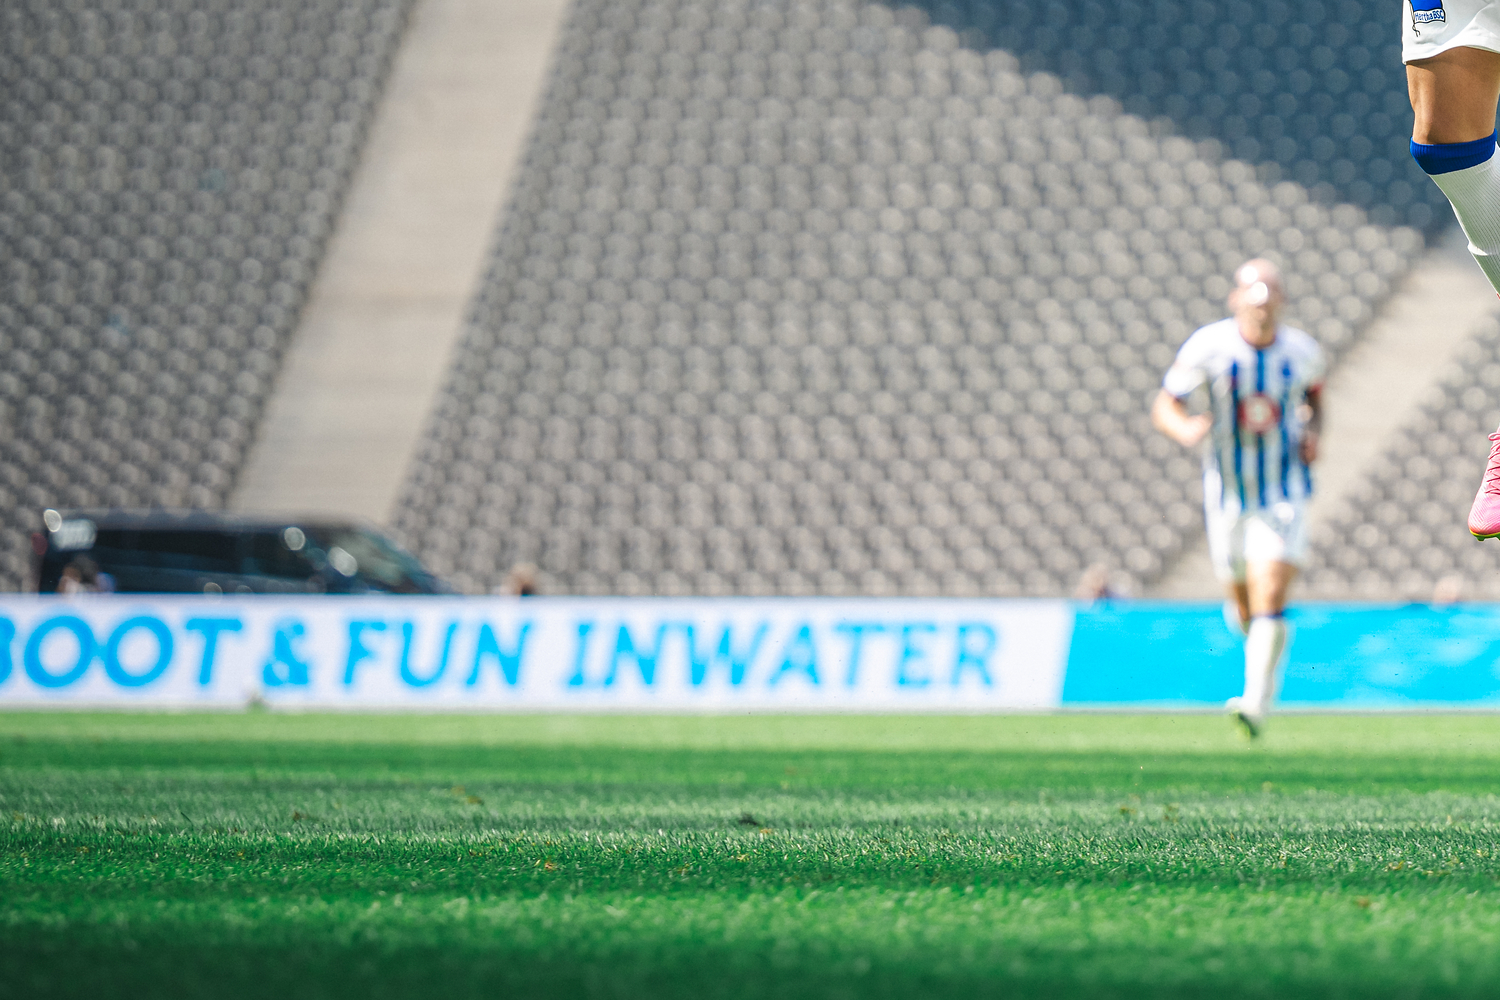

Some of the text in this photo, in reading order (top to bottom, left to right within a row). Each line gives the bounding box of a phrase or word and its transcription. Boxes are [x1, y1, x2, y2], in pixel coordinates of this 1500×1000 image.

[1415, 10, 1445, 21] Hertha BSC
[0, 613, 997, 690] OOT & FUN INWATER
